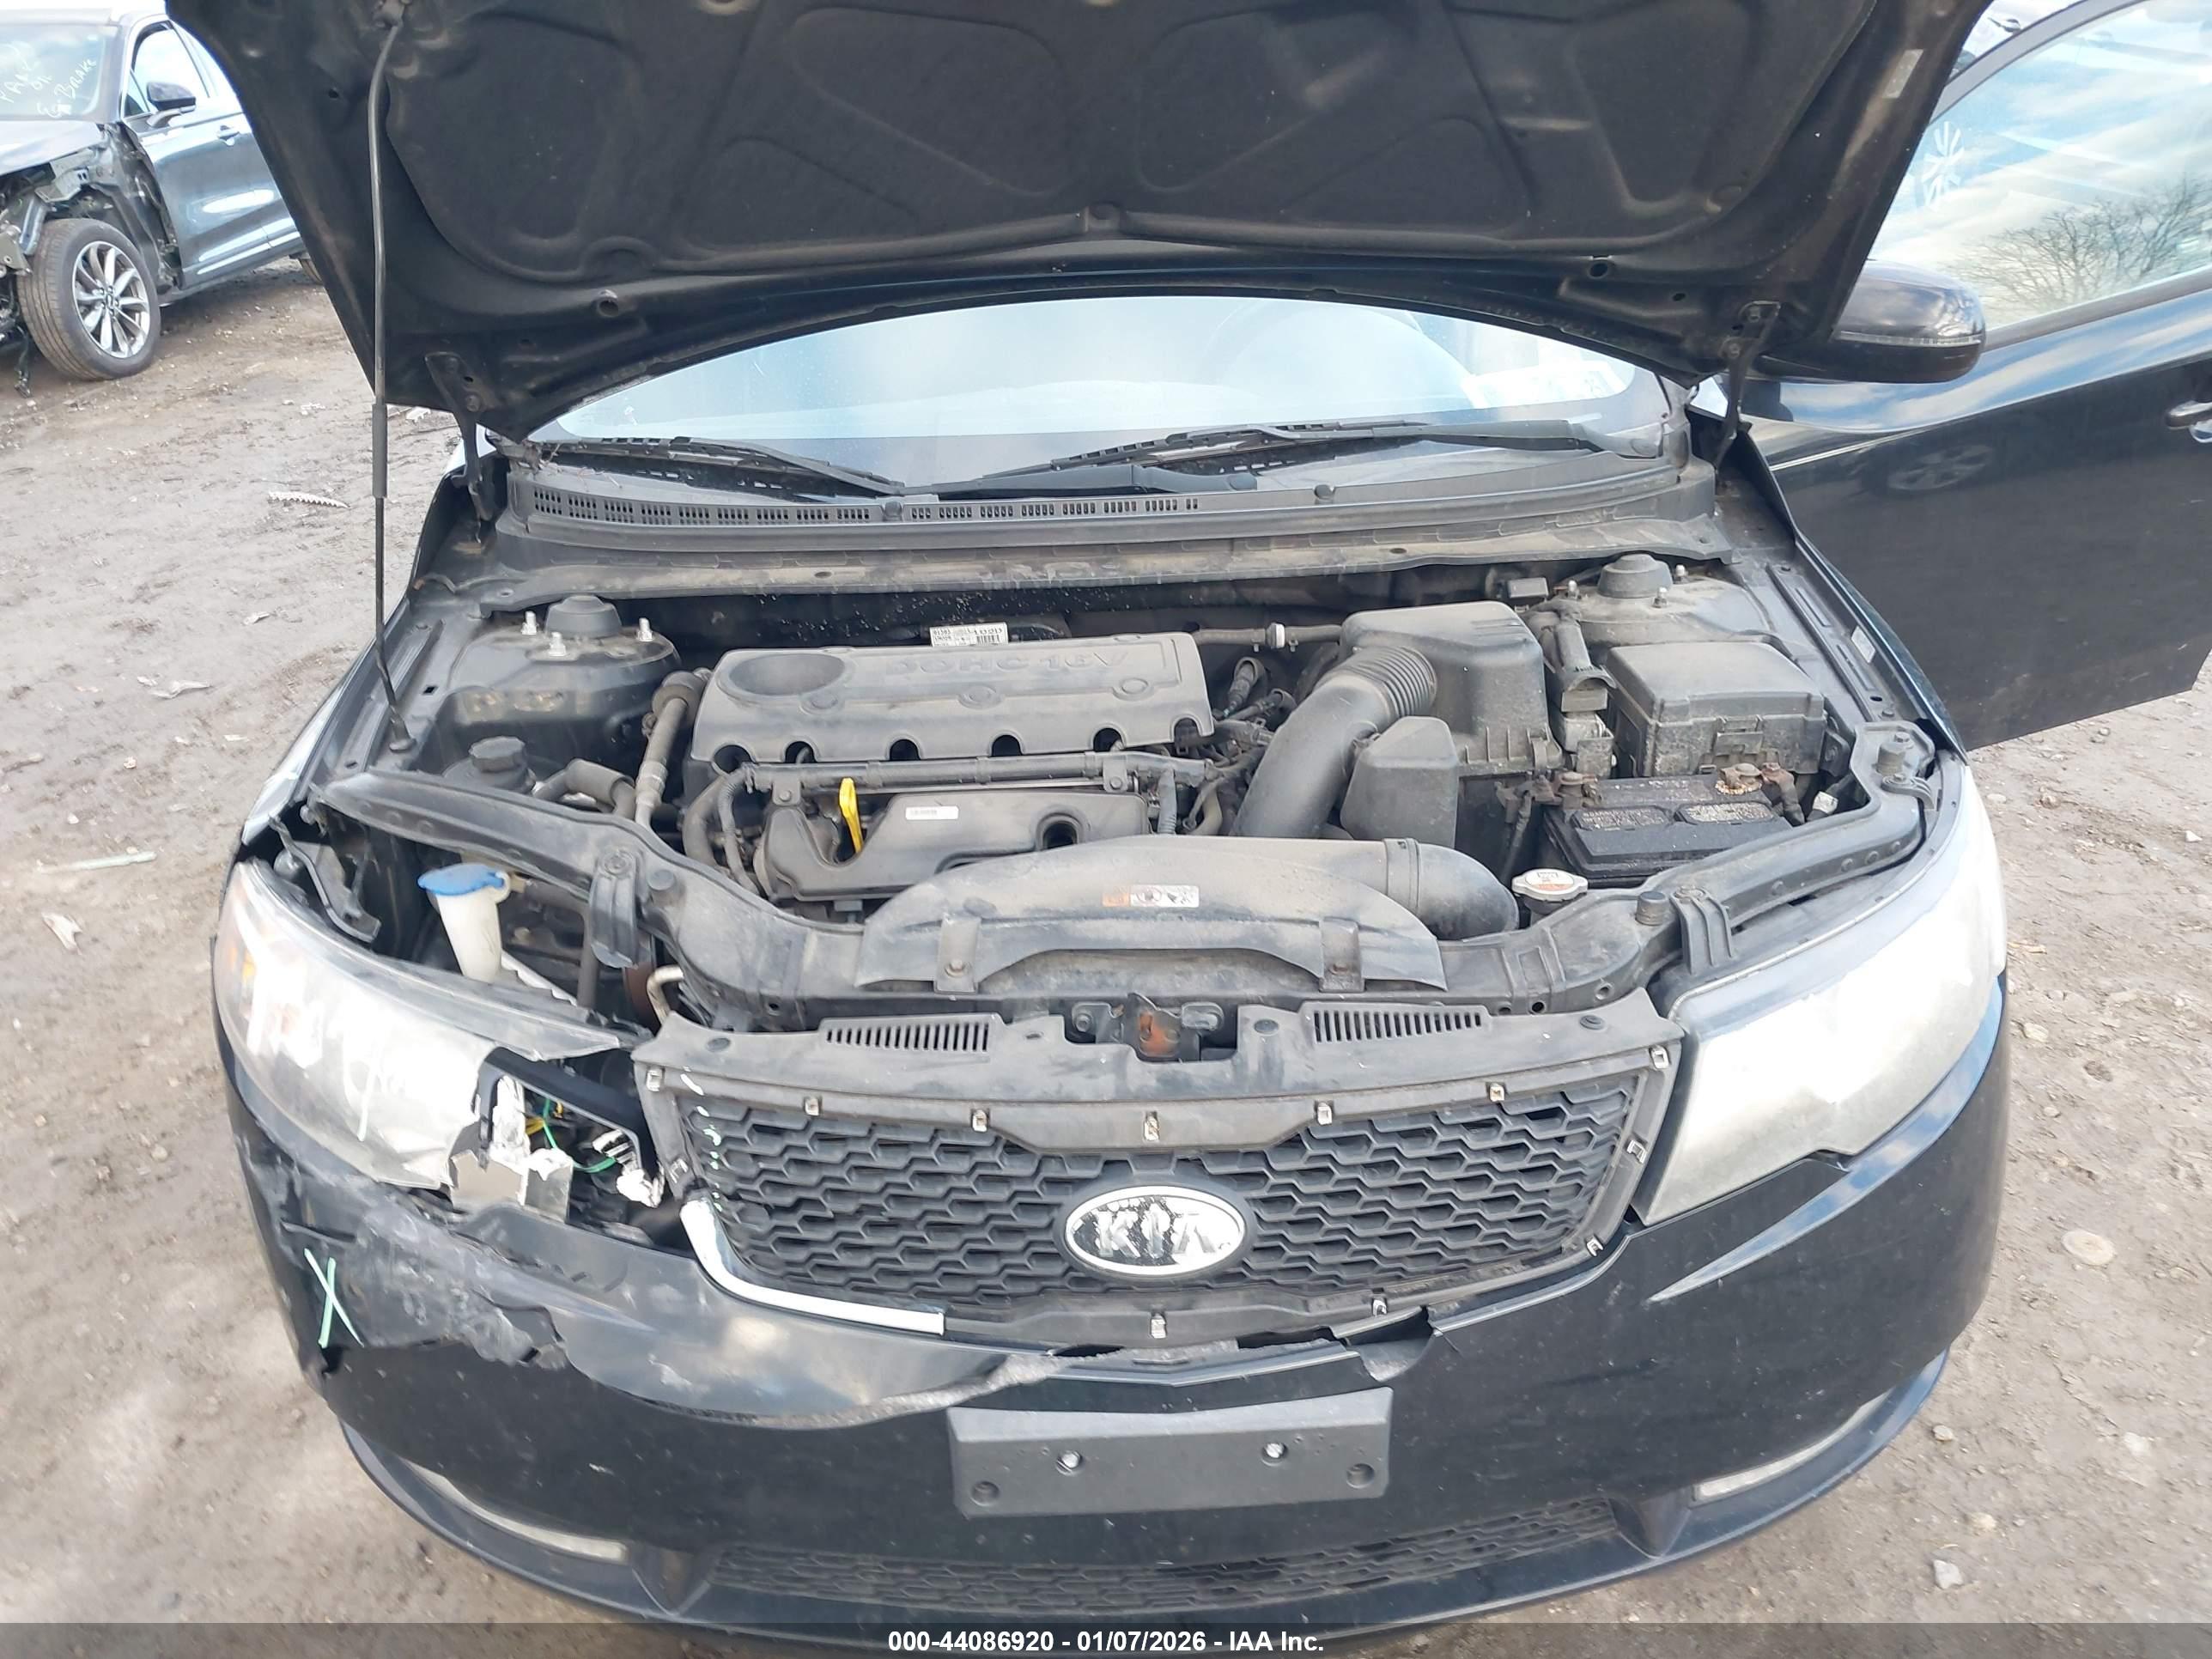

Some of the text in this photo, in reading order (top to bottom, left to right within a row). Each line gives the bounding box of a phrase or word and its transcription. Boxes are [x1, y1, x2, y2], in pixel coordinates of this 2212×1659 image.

[885, 651, 1129, 674] DOHC 16V
[1095, 1205, 1217, 1258] KIA
